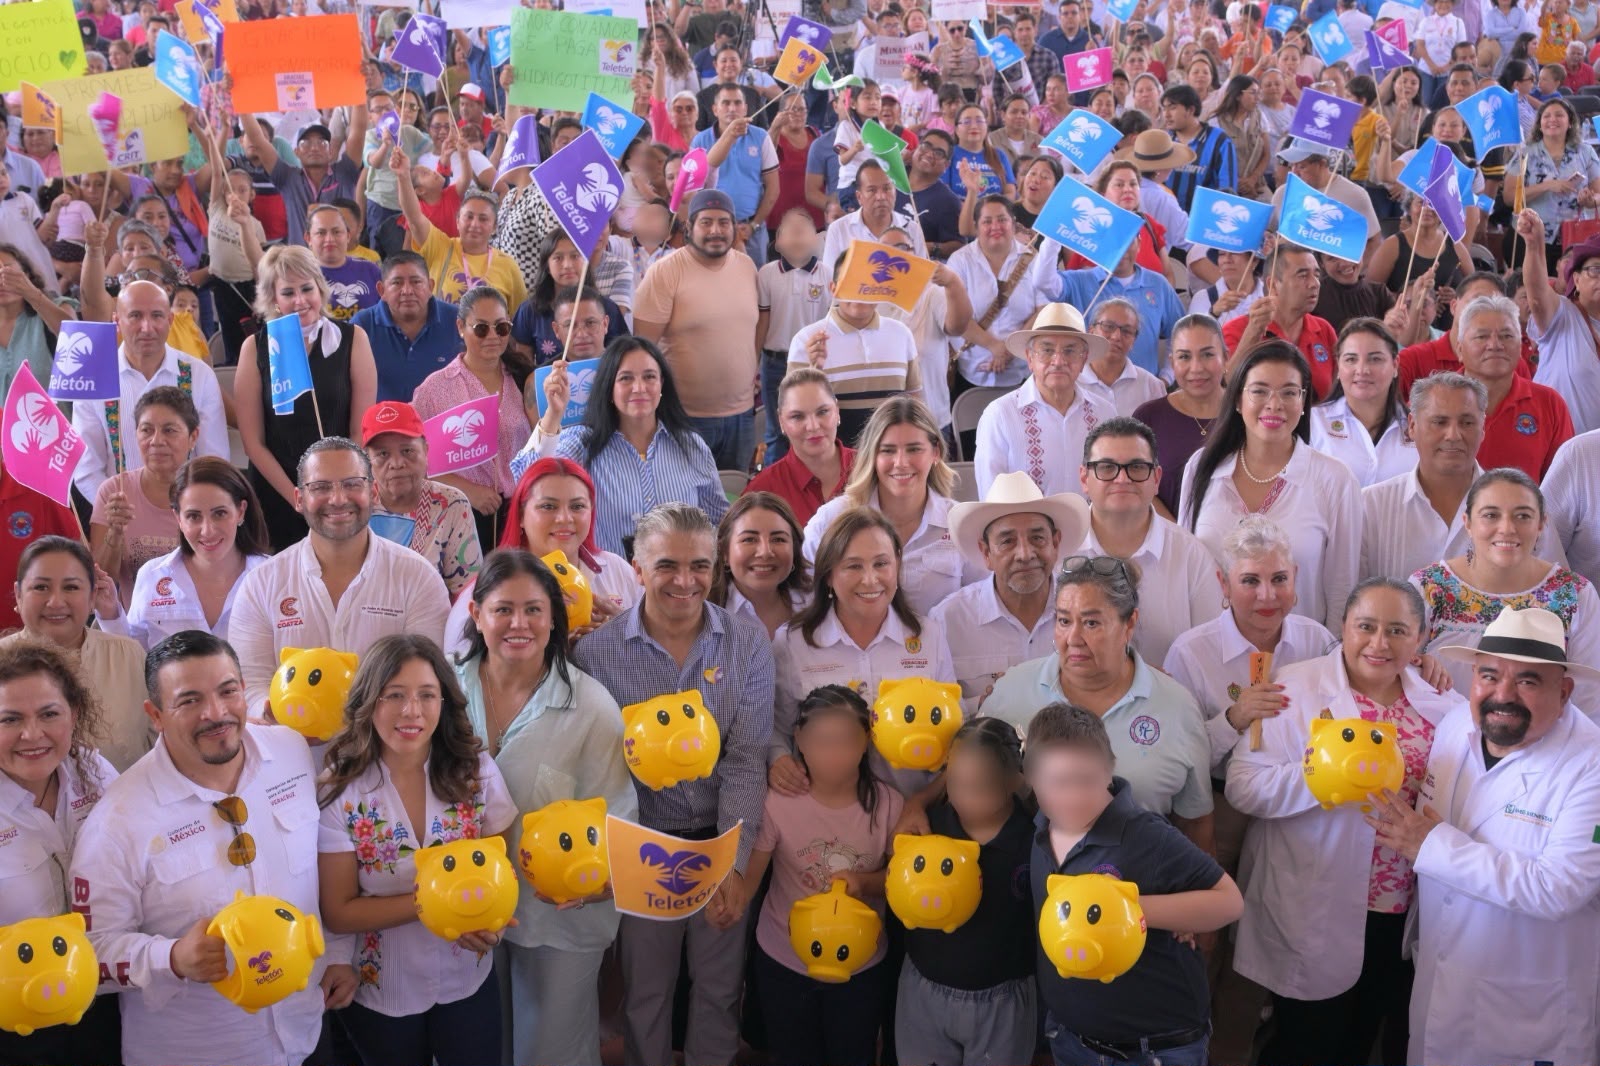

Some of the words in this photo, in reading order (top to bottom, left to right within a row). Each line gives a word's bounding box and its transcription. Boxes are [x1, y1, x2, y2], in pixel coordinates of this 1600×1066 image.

[601, 62, 633, 74] Teletón
[62, 71, 157, 102] PROMES
[1303, 123, 1333, 141] Teletón
[116, 151, 140, 163] CRIT
[1054, 135, 1084, 160] Teletón
[551, 181, 590, 236] Teletón
[1056, 223, 1098, 253] Teletón
[1203, 228, 1243, 247] Teletón
[1296, 224, 1342, 248] Teletón
[857, 283, 898, 298] Teletón
[563, 405, 588, 419] Tele
[445, 444, 488, 464] Teletón
[277, 619, 304, 629] COATZA
[169, 825, 206, 845] México
[644, 882, 717, 911] Teletón
